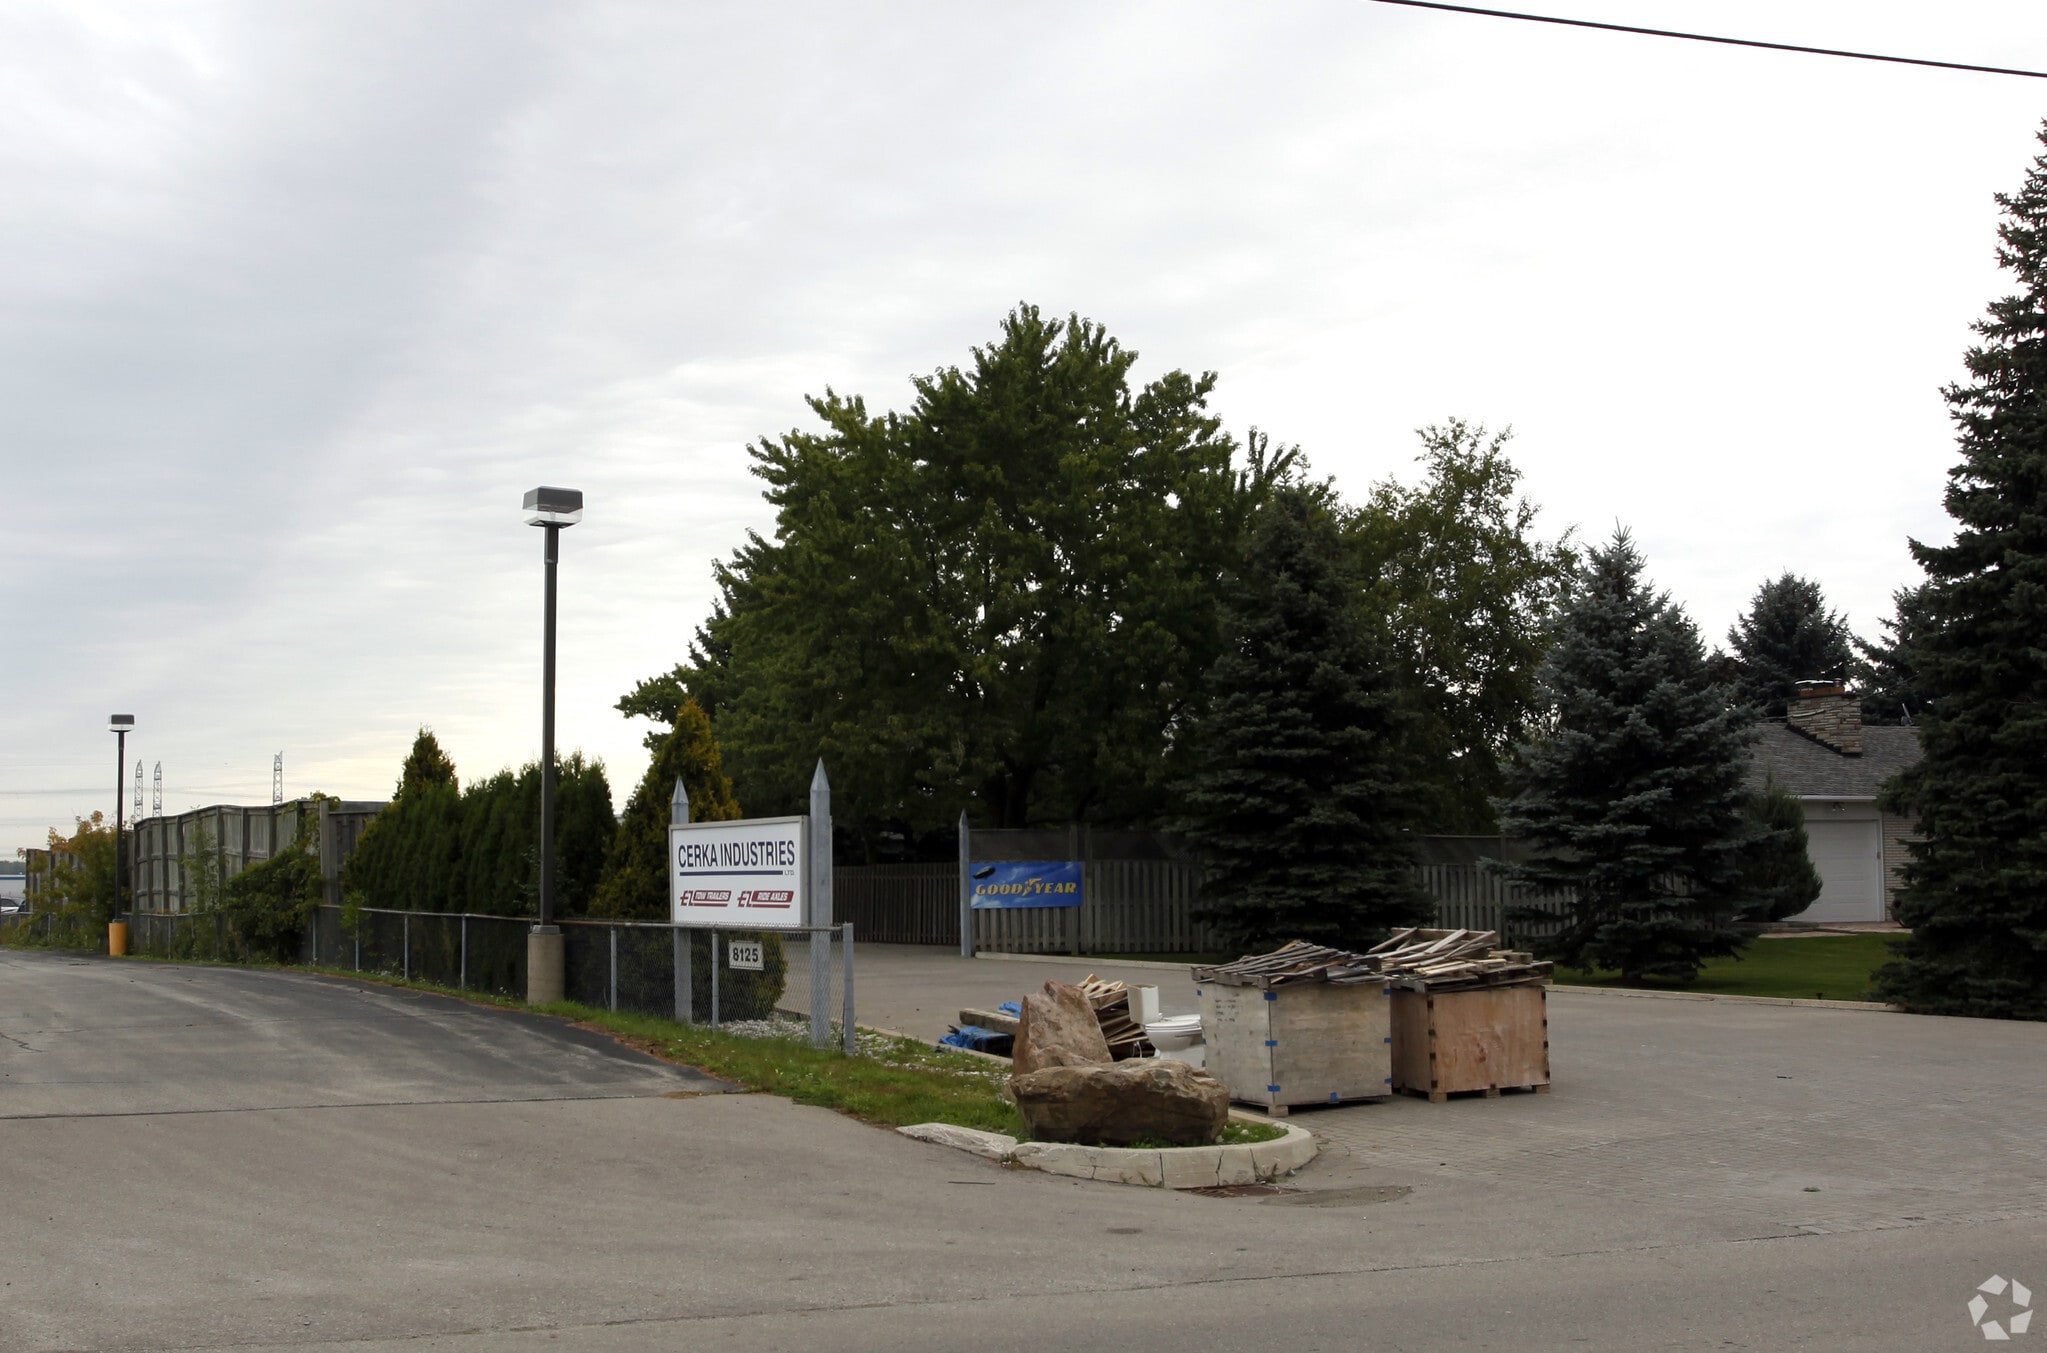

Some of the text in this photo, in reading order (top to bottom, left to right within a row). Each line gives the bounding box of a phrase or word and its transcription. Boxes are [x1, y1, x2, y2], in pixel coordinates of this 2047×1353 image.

[678, 840, 795, 867] CERKA INDUSTRIES
[975, 880, 1077, 896] GOODYEAR
[732, 948, 759, 963] 8125
